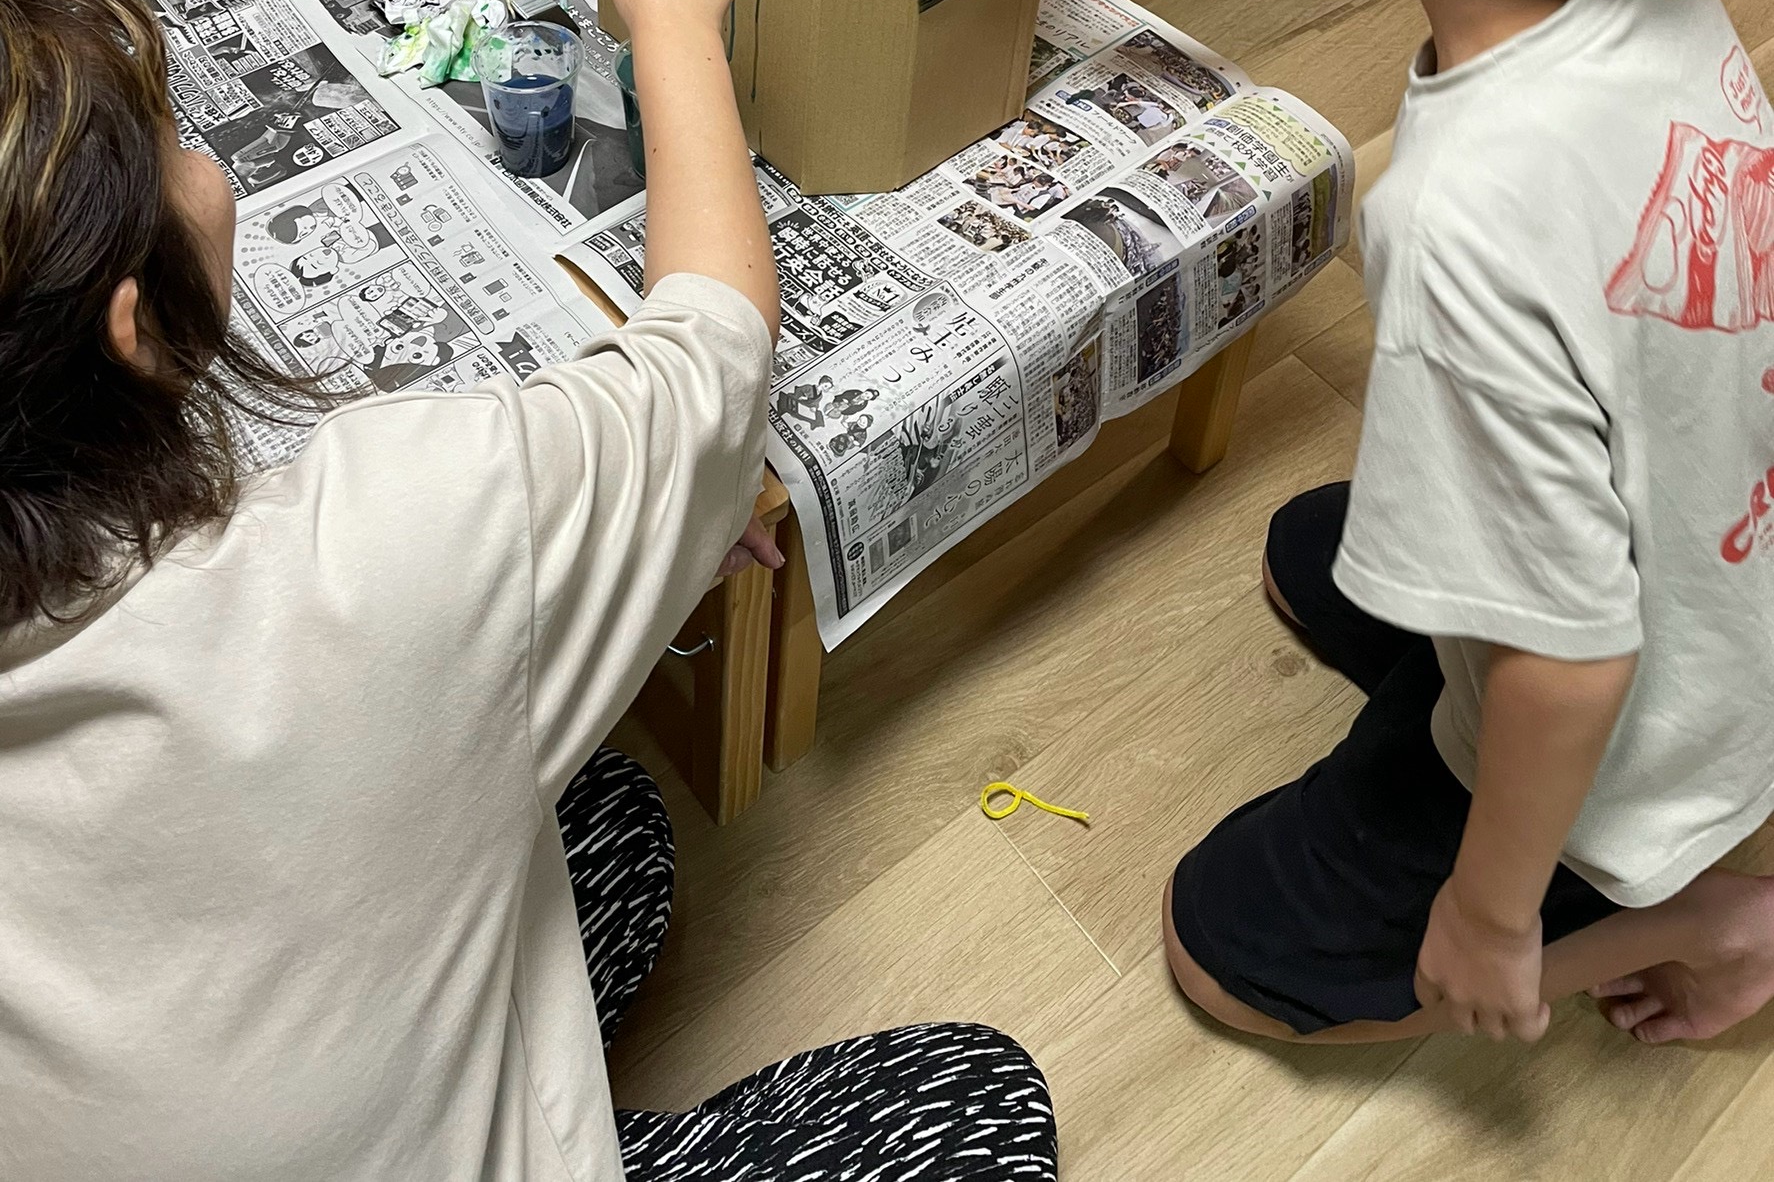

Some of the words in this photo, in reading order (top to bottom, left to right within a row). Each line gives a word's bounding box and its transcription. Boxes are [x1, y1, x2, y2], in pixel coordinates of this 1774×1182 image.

[777, 225, 853, 288] 瞬時に話せる
[800, 225, 853, 269] 世界中使える
[923, 448, 1024, 530] 太陽の心で
